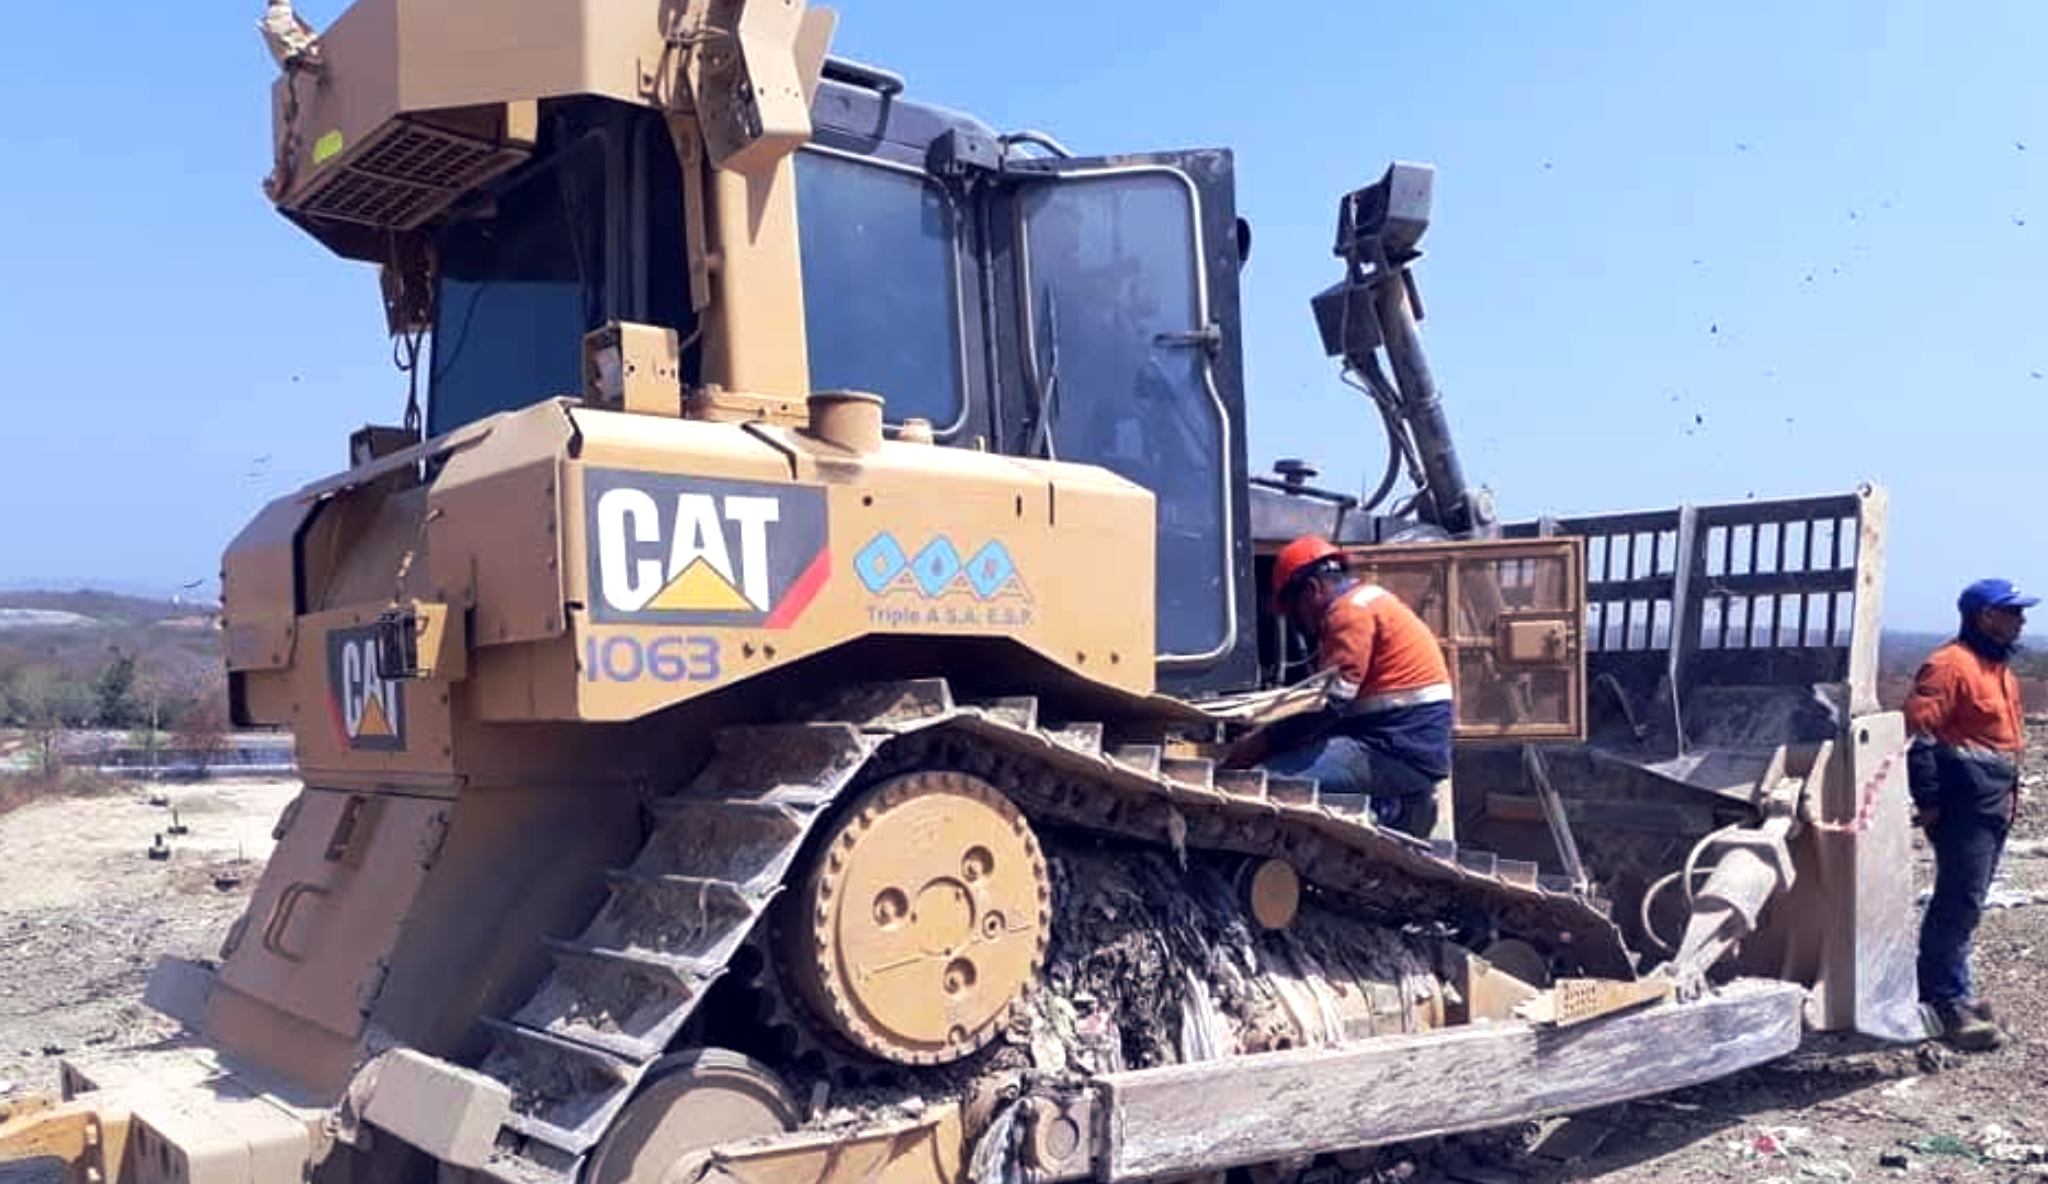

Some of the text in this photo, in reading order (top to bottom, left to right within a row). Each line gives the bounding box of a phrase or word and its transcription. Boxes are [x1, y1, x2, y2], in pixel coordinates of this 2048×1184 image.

[598, 487, 780, 612] CAT
[868, 605, 921, 626] Triple
[927, 607, 940, 623] A
[586, 635, 721, 682] 1063
